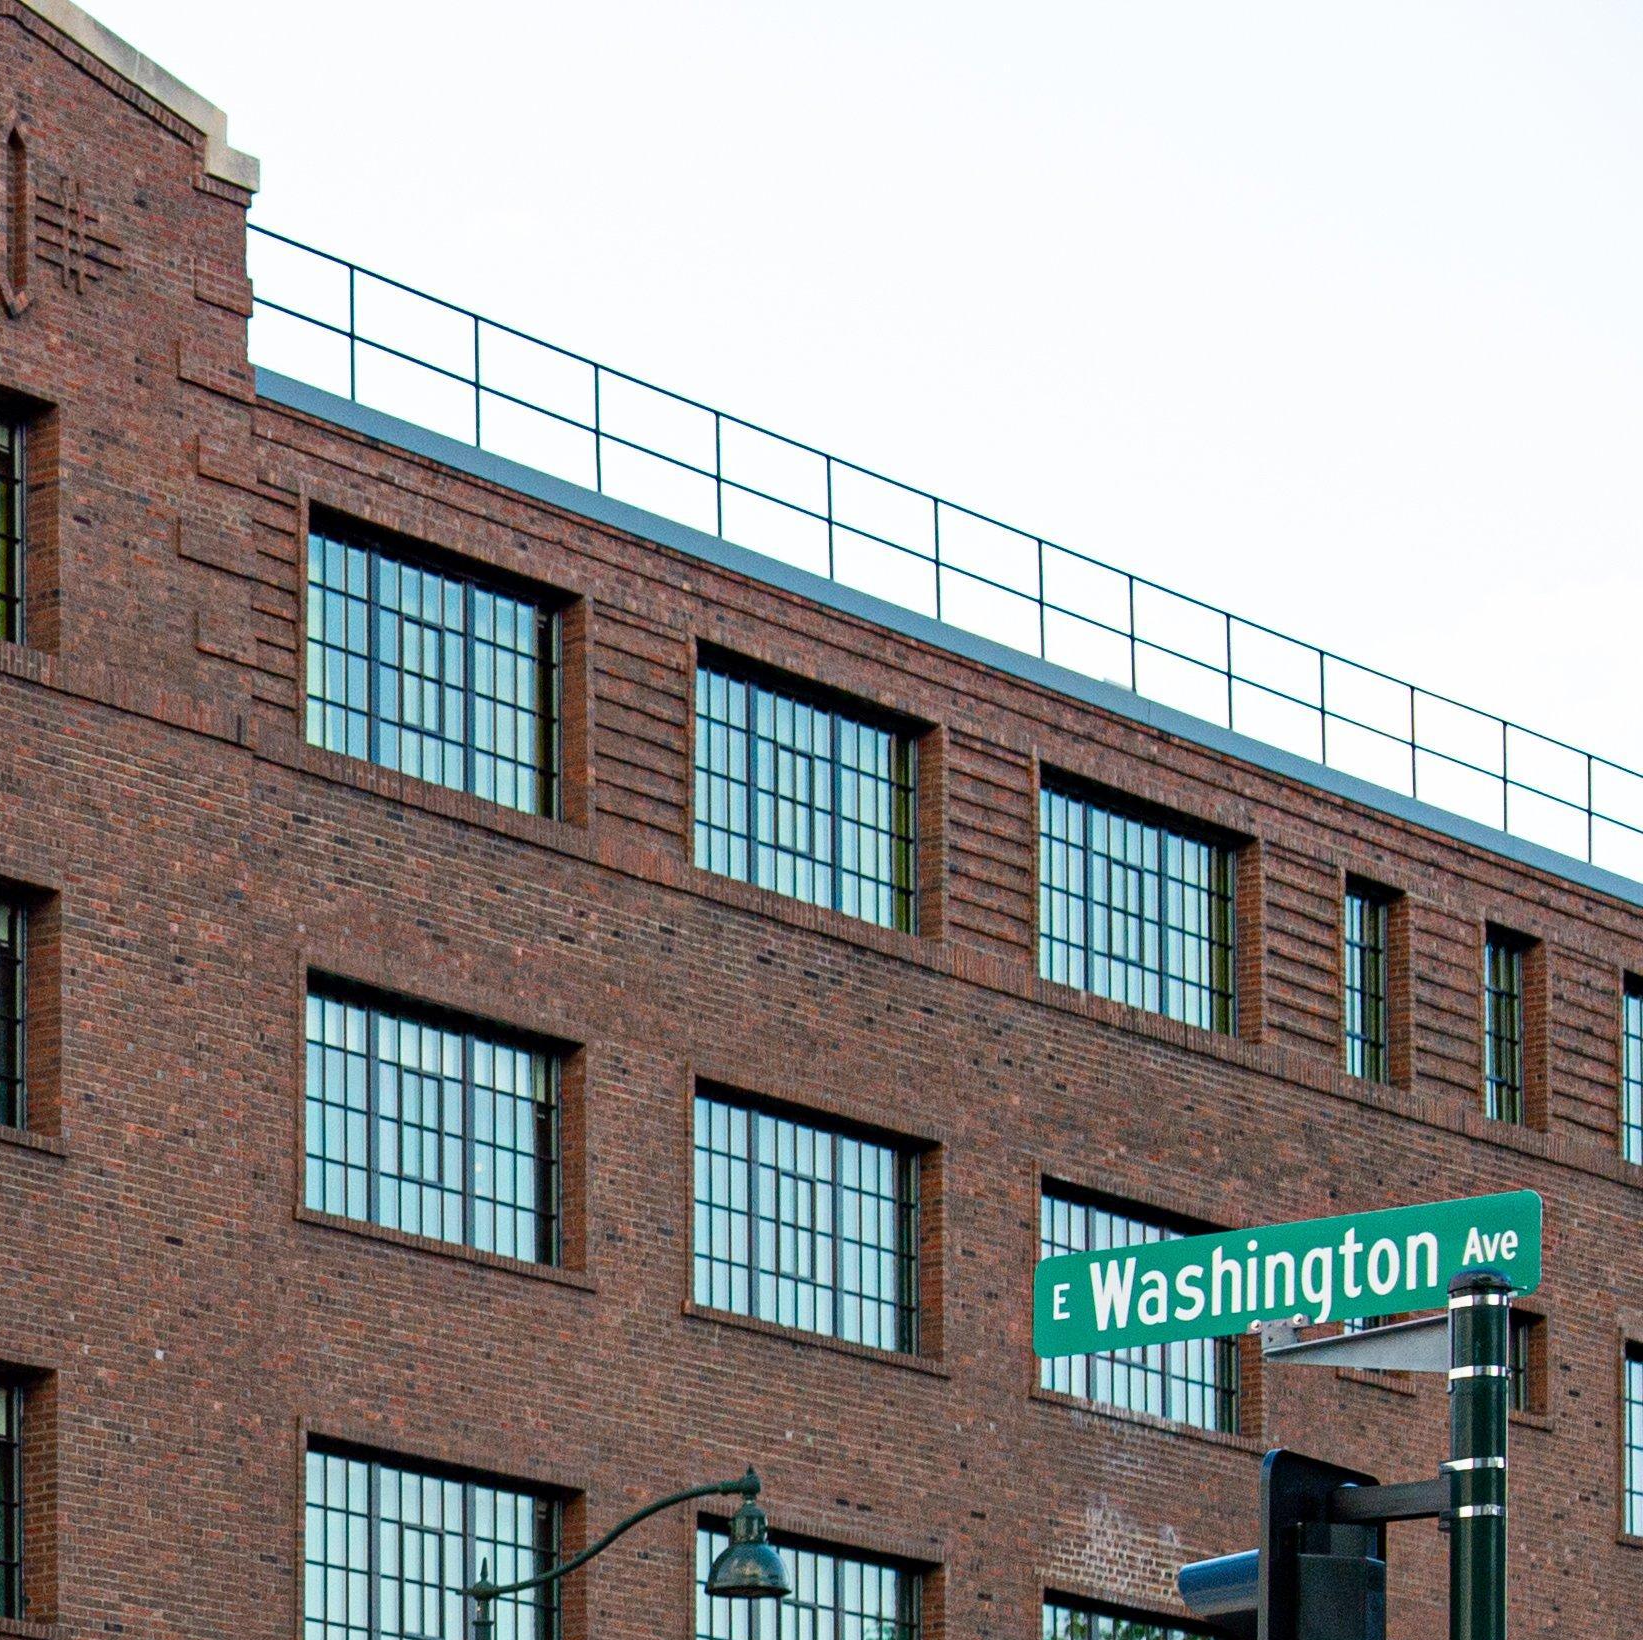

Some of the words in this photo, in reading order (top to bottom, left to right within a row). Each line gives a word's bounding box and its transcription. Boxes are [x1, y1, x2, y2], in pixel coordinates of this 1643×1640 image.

[1053, 1284, 1071, 1321] E
[1090, 1227, 1439, 1331] Washington
[1462, 1226, 1519, 1266] Ave
